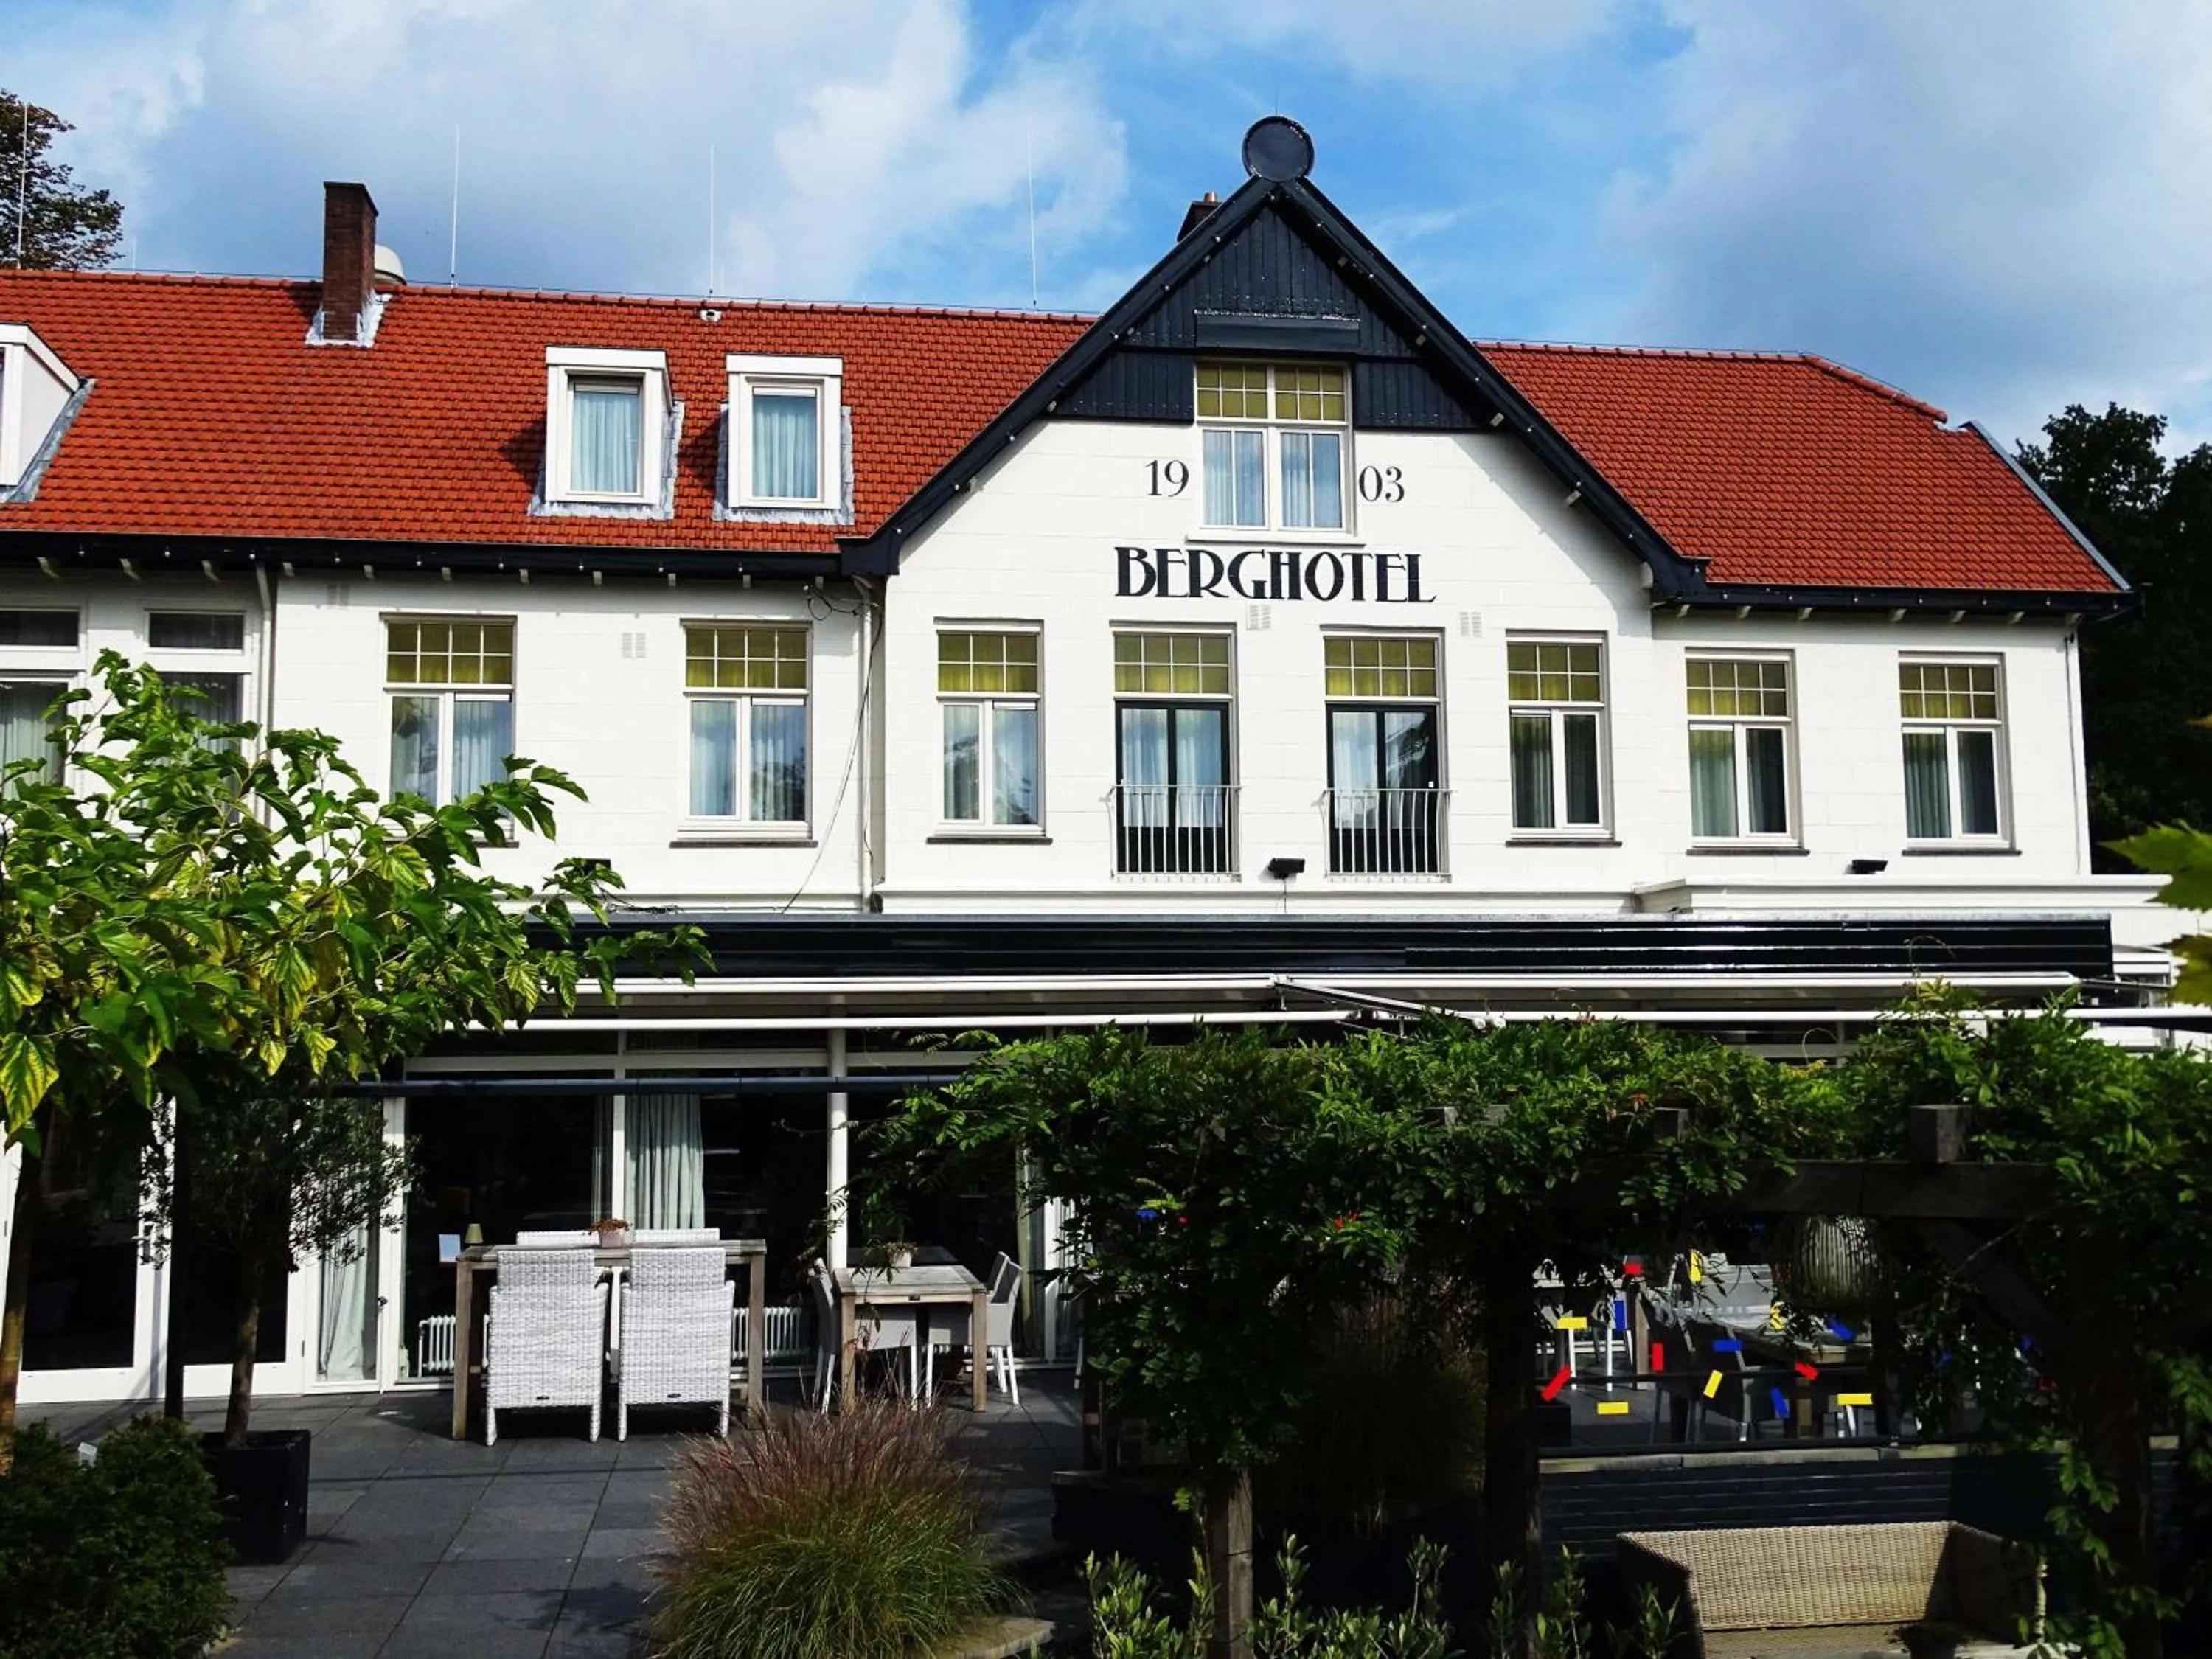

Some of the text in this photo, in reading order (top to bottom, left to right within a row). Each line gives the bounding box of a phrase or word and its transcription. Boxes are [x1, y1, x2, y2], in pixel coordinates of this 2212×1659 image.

[1145, 459, 1405, 503] 19 03
[1114, 546, 1437, 603] BERGHOTEL
